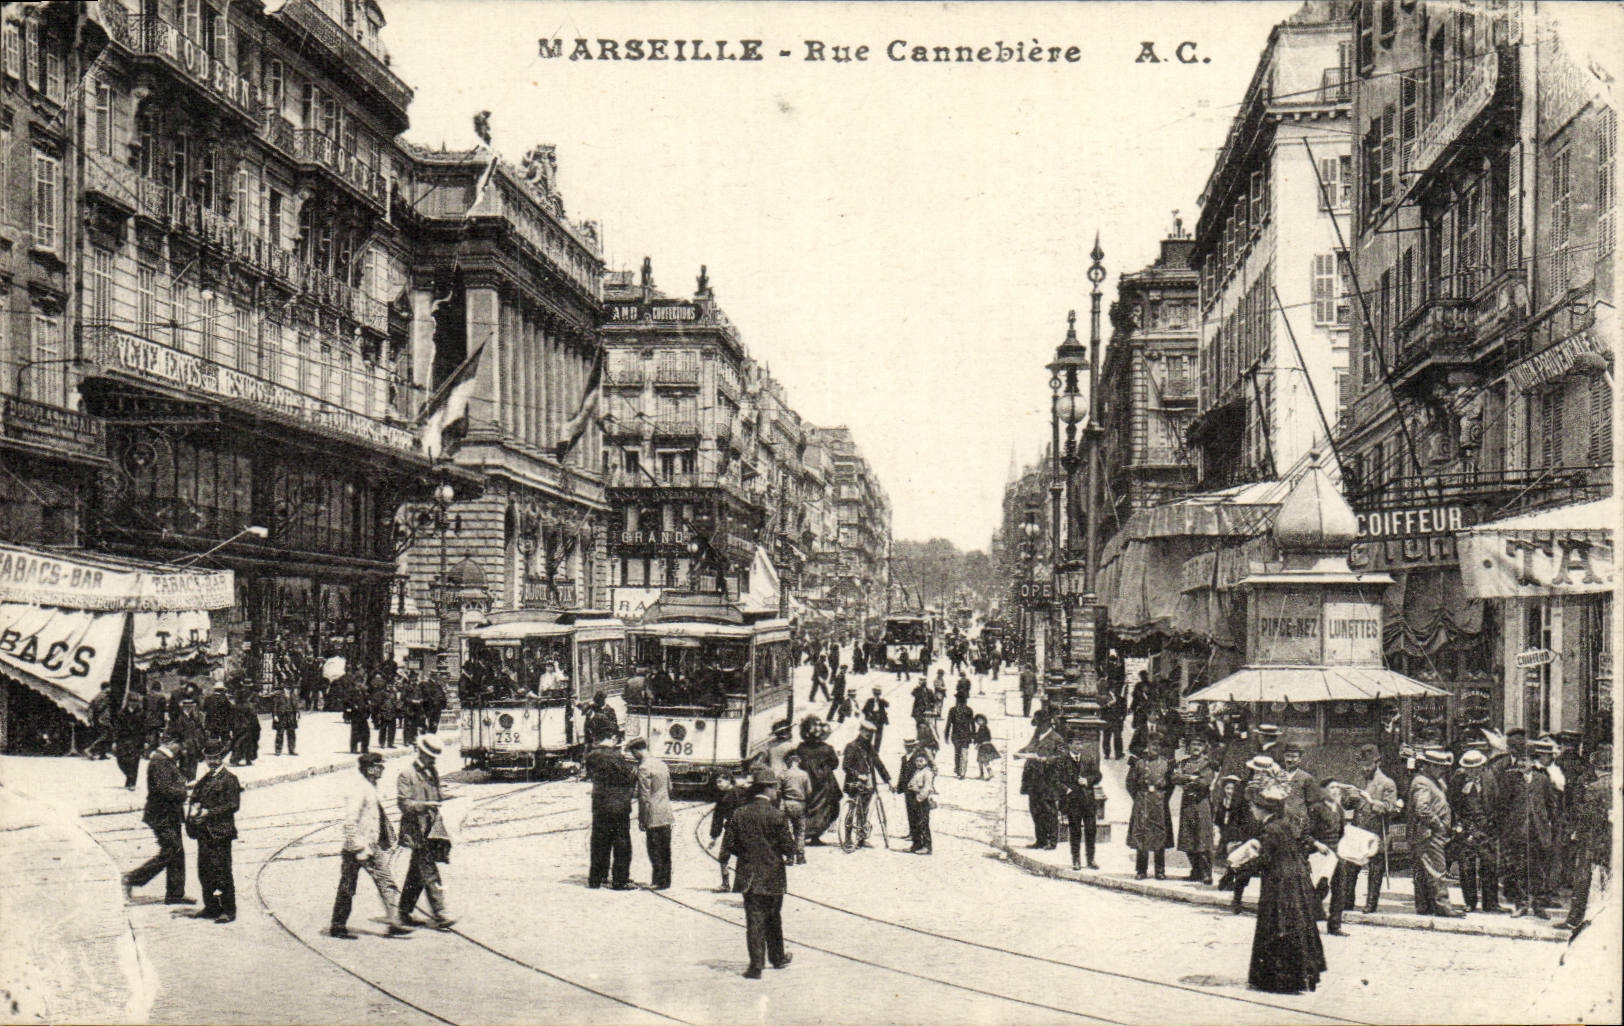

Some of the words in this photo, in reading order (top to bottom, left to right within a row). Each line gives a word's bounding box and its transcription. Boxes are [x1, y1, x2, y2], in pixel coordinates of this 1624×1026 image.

[1355, 506, 1463, 537] COIFFEUR
[621, 531, 684, 544] GRAND
[0, 552, 103, 589] ABACS-BAR
[1329, 619, 1379, 639] LUNETTES
[496, 732, 521, 743] 732
[664, 741, 694, 756] 708
